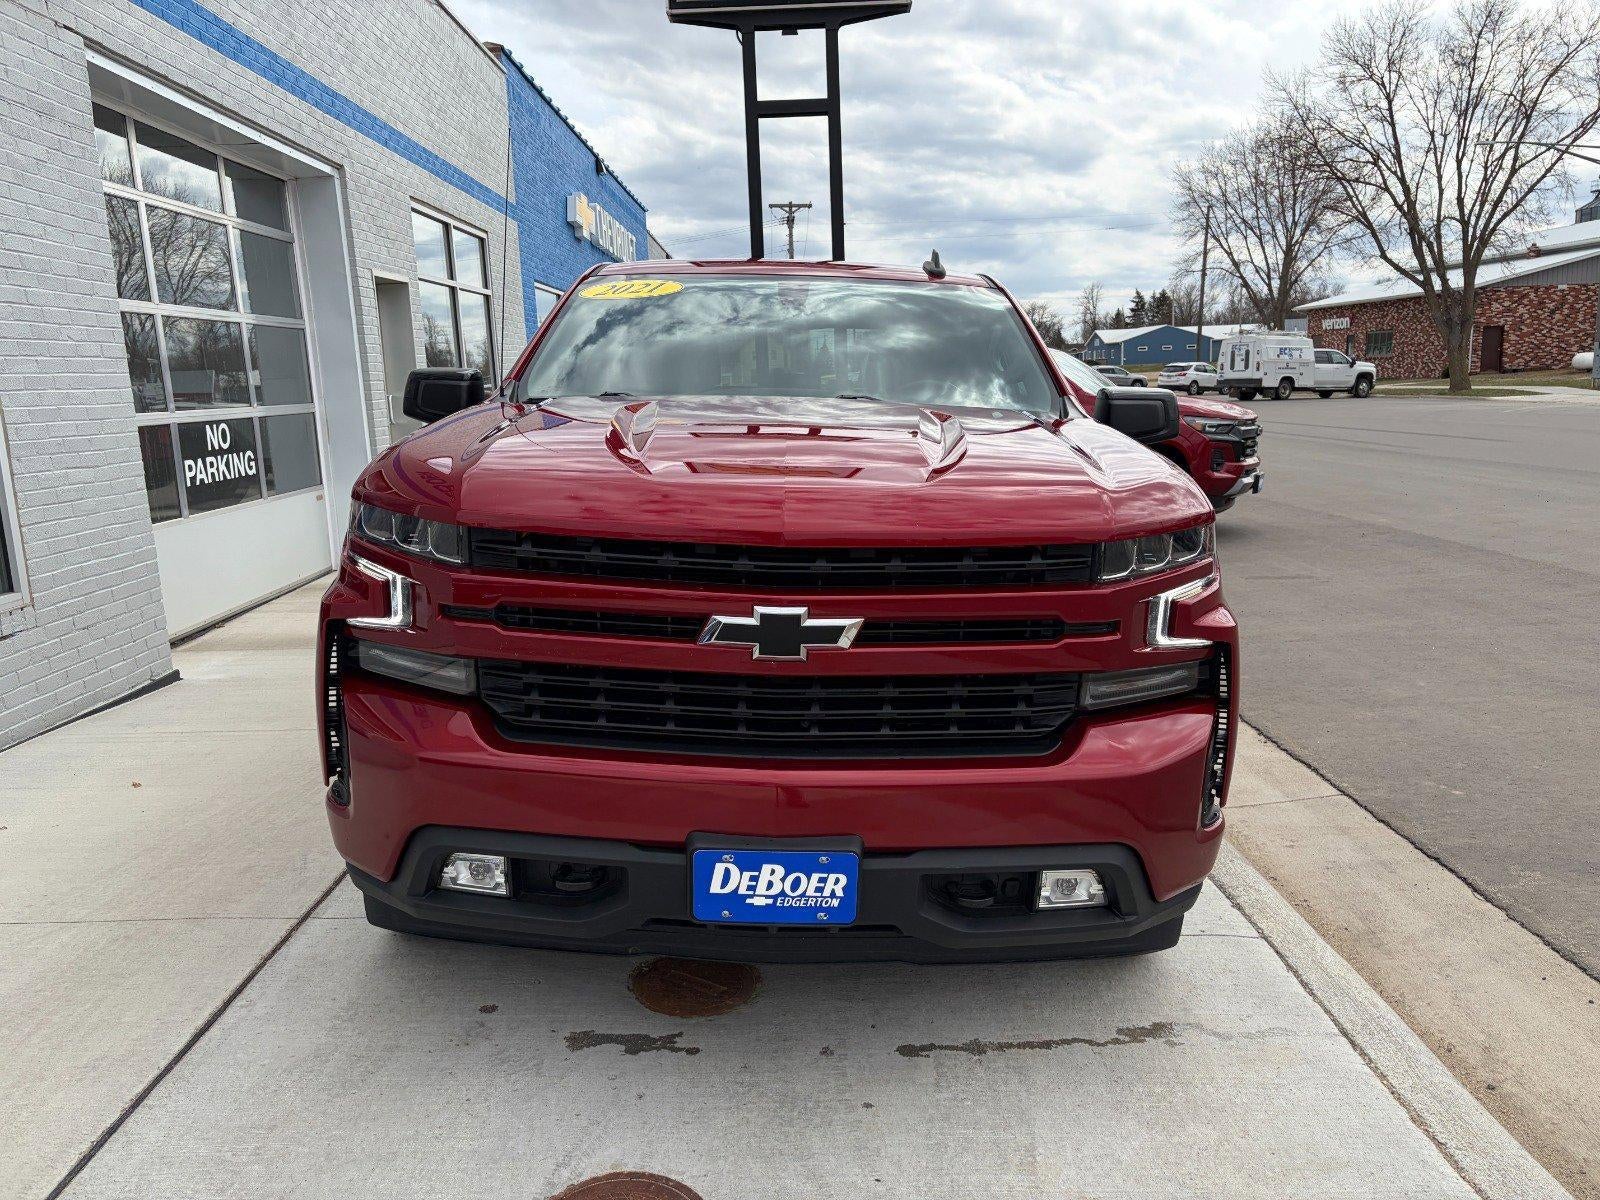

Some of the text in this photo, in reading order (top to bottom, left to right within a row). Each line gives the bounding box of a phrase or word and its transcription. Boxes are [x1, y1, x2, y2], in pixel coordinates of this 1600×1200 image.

[592, 282, 667, 297] 2021
[1322, 315, 1350, 330] verizon
[205, 422, 231, 451] NO
[183, 450, 257, 488] PARKING
[776, 897, 841, 908] EDGERTON
